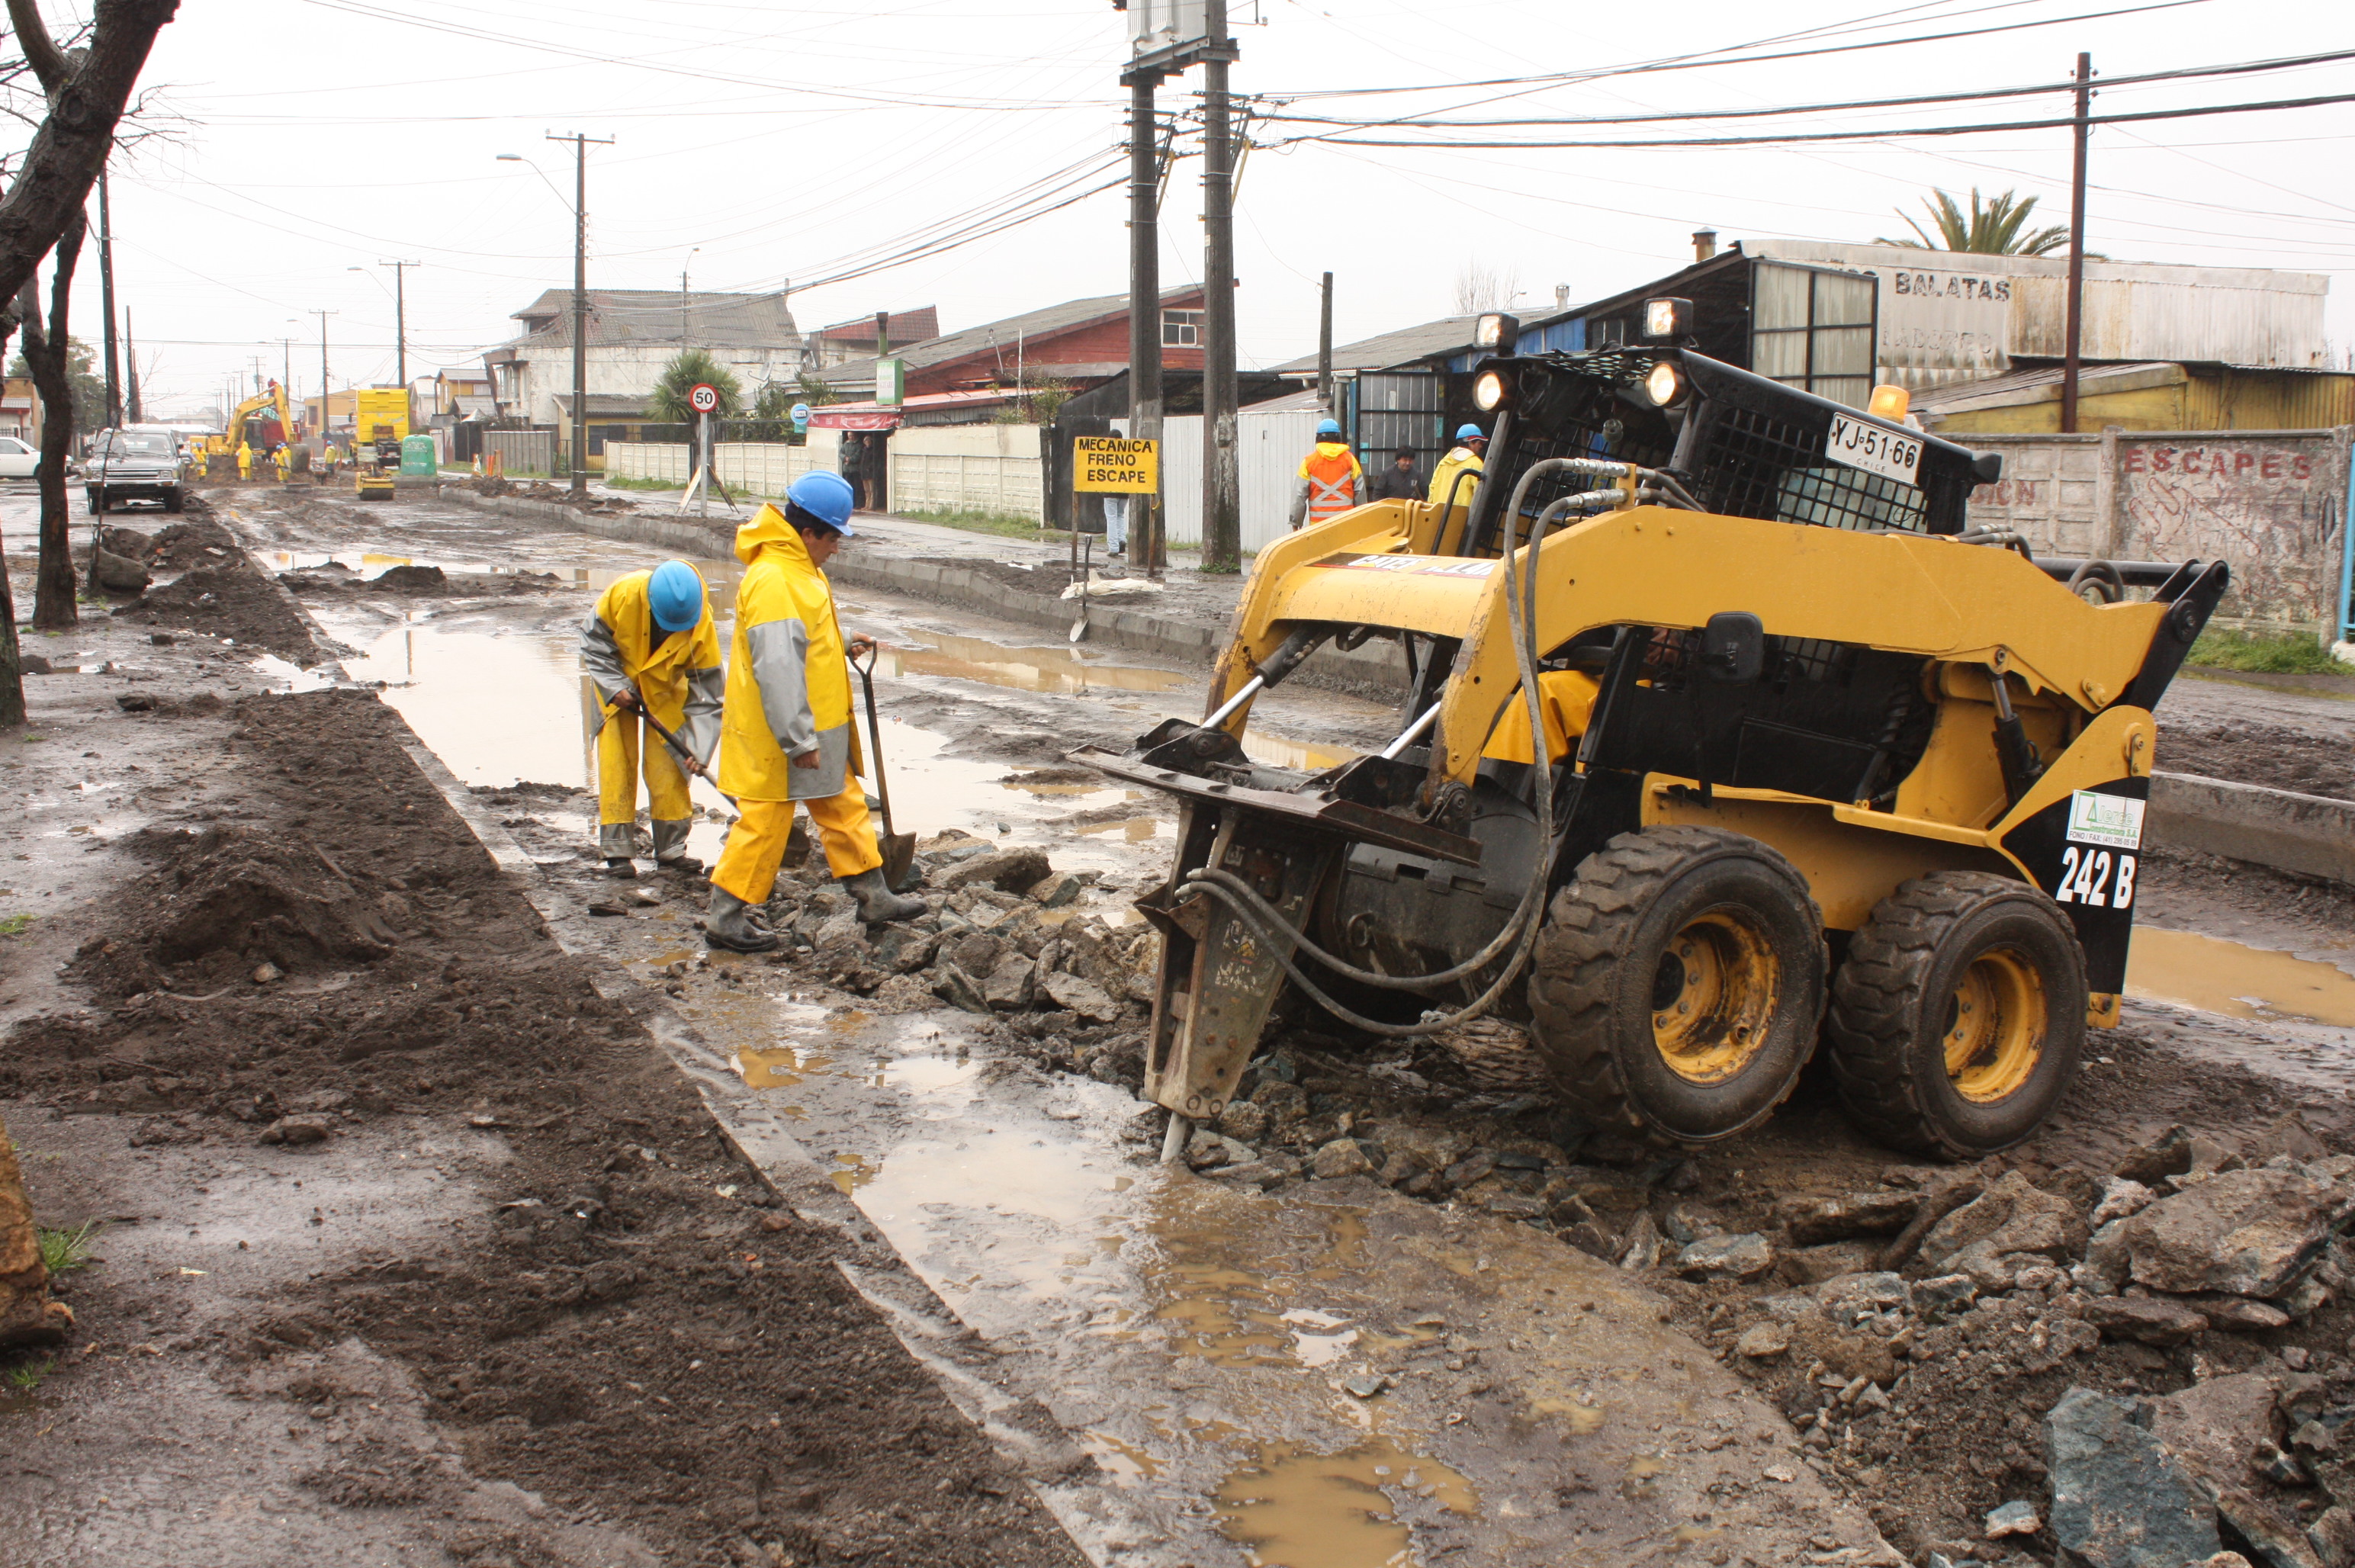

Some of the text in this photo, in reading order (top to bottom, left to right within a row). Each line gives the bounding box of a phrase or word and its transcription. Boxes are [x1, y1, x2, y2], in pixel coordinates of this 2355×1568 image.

[1895, 272, 2010, 301] BALATAS
[696, 392, 713, 404] 50
[1078, 439, 1153, 453] MECANICA
[1088, 453, 1136, 466] FRENO
[1857, 458, 1886, 472] CHILE
[2123, 448, 2311, 480] ESCAPES
[1088, 469, 1145, 483] ESCAPE
[2069, 831, 2086, 840] FONO
[2056, 847, 2136, 909] 242 B
